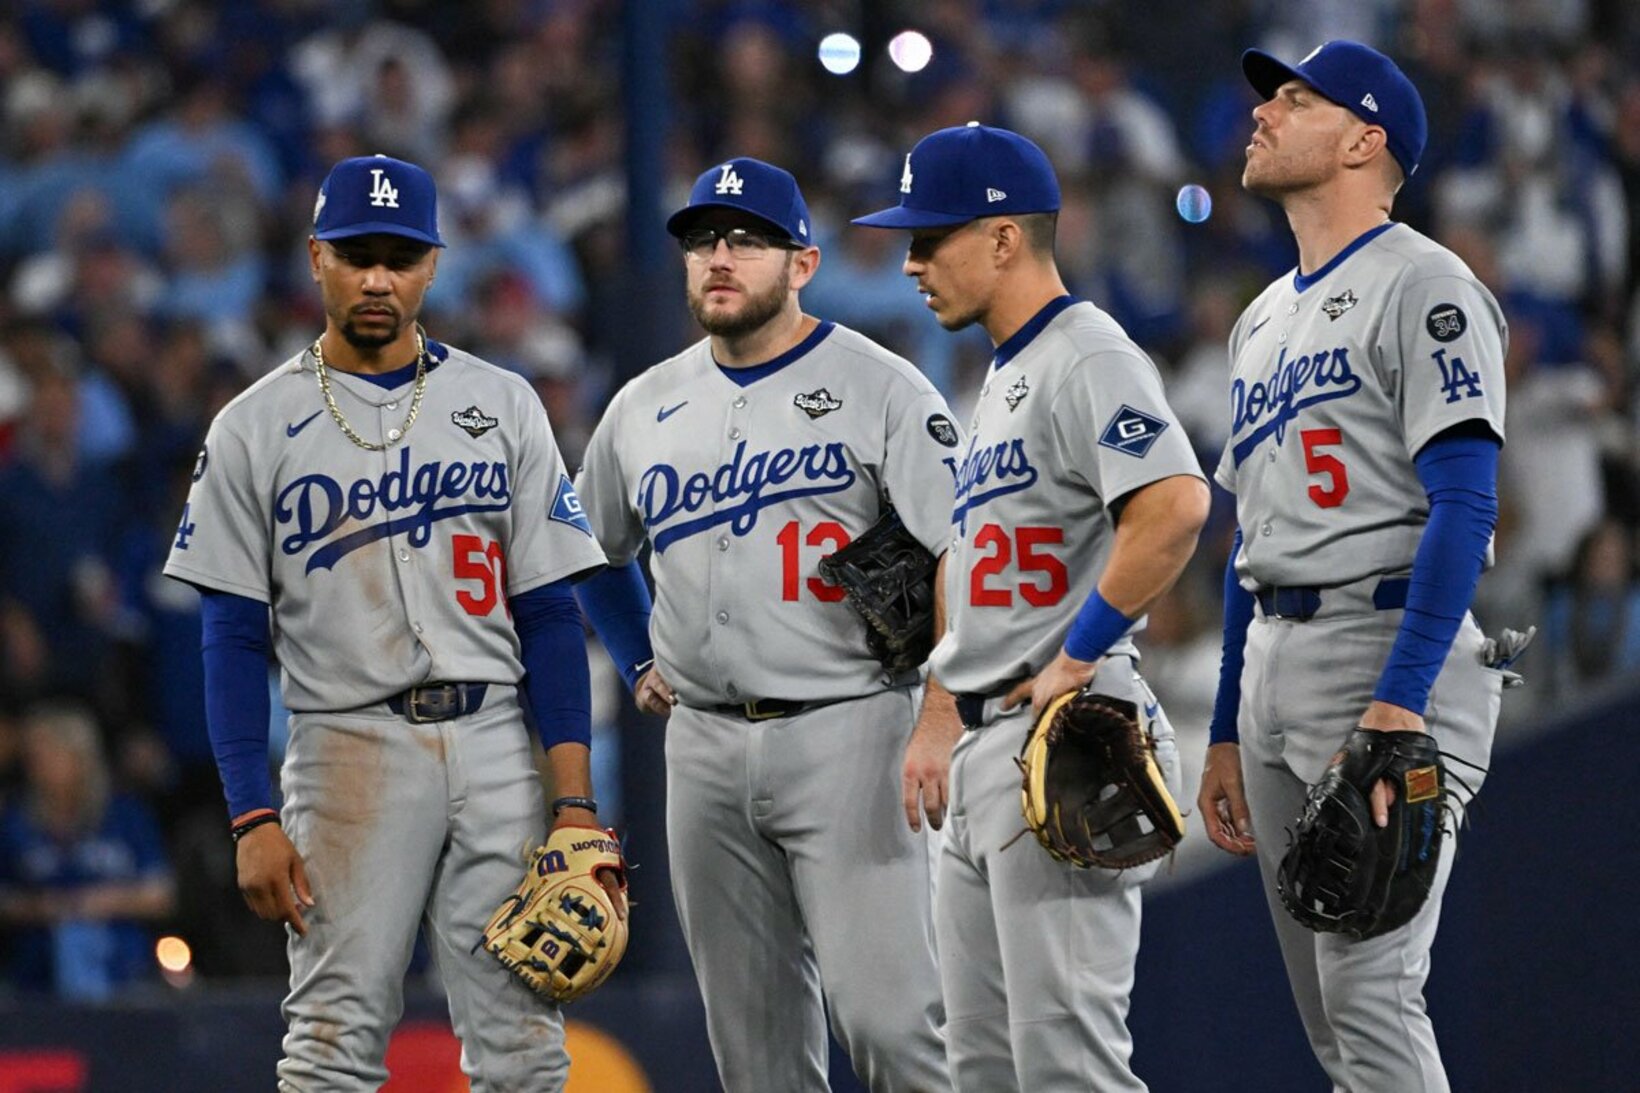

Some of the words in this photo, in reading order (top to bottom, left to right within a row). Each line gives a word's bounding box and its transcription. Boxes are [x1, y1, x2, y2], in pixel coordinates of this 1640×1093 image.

[369, 169, 400, 208] LA
[715, 164, 744, 195] LA
[1434, 315, 1460, 337] 34
[1431, 348, 1483, 404] LA
[1118, 418, 1146, 439] G
[1300, 428, 1349, 509] 5
[275, 447, 512, 577] Dodgers
[563, 492, 582, 513] G
[636, 440, 856, 554] Dodgers
[776, 520, 851, 602] 13
[970, 523, 1070, 608] 25
